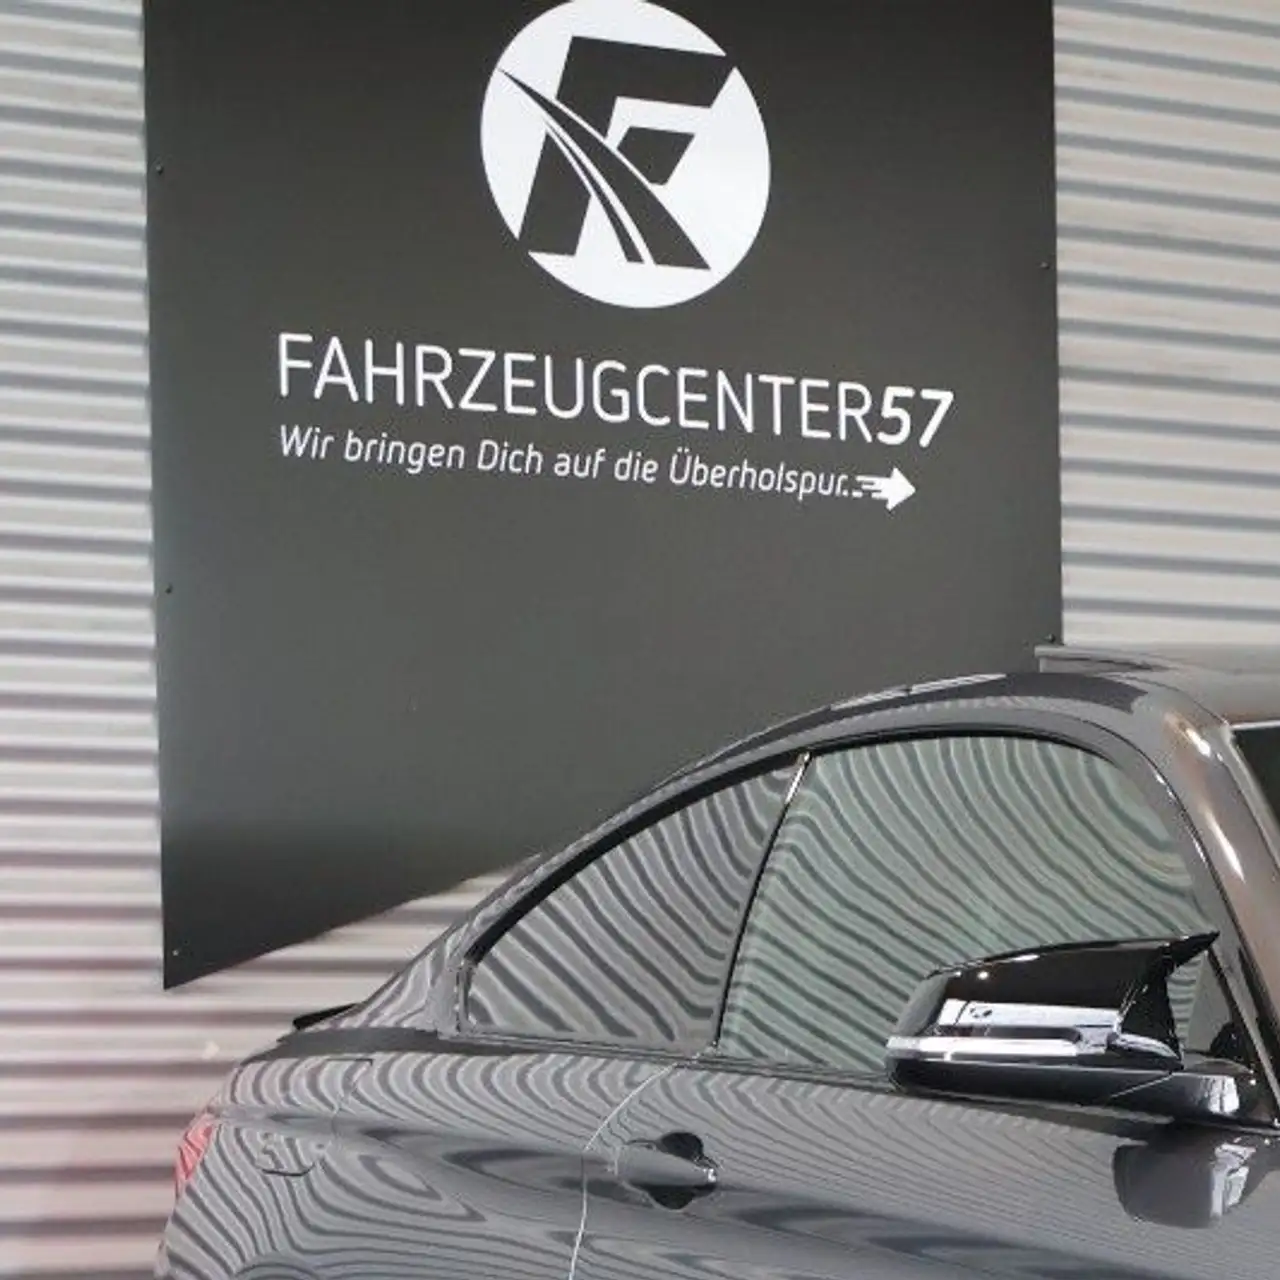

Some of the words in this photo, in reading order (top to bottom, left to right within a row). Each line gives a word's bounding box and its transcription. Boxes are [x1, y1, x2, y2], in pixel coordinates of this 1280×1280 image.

[277, 332, 955, 448] FAHRZEUGCENTER57
[279, 424, 334, 460] Wir
[344, 429, 465, 475] bringen
[477, 439, 543, 474] Dich
[553, 448, 606, 479] auf
[613, 450, 659, 483] die
